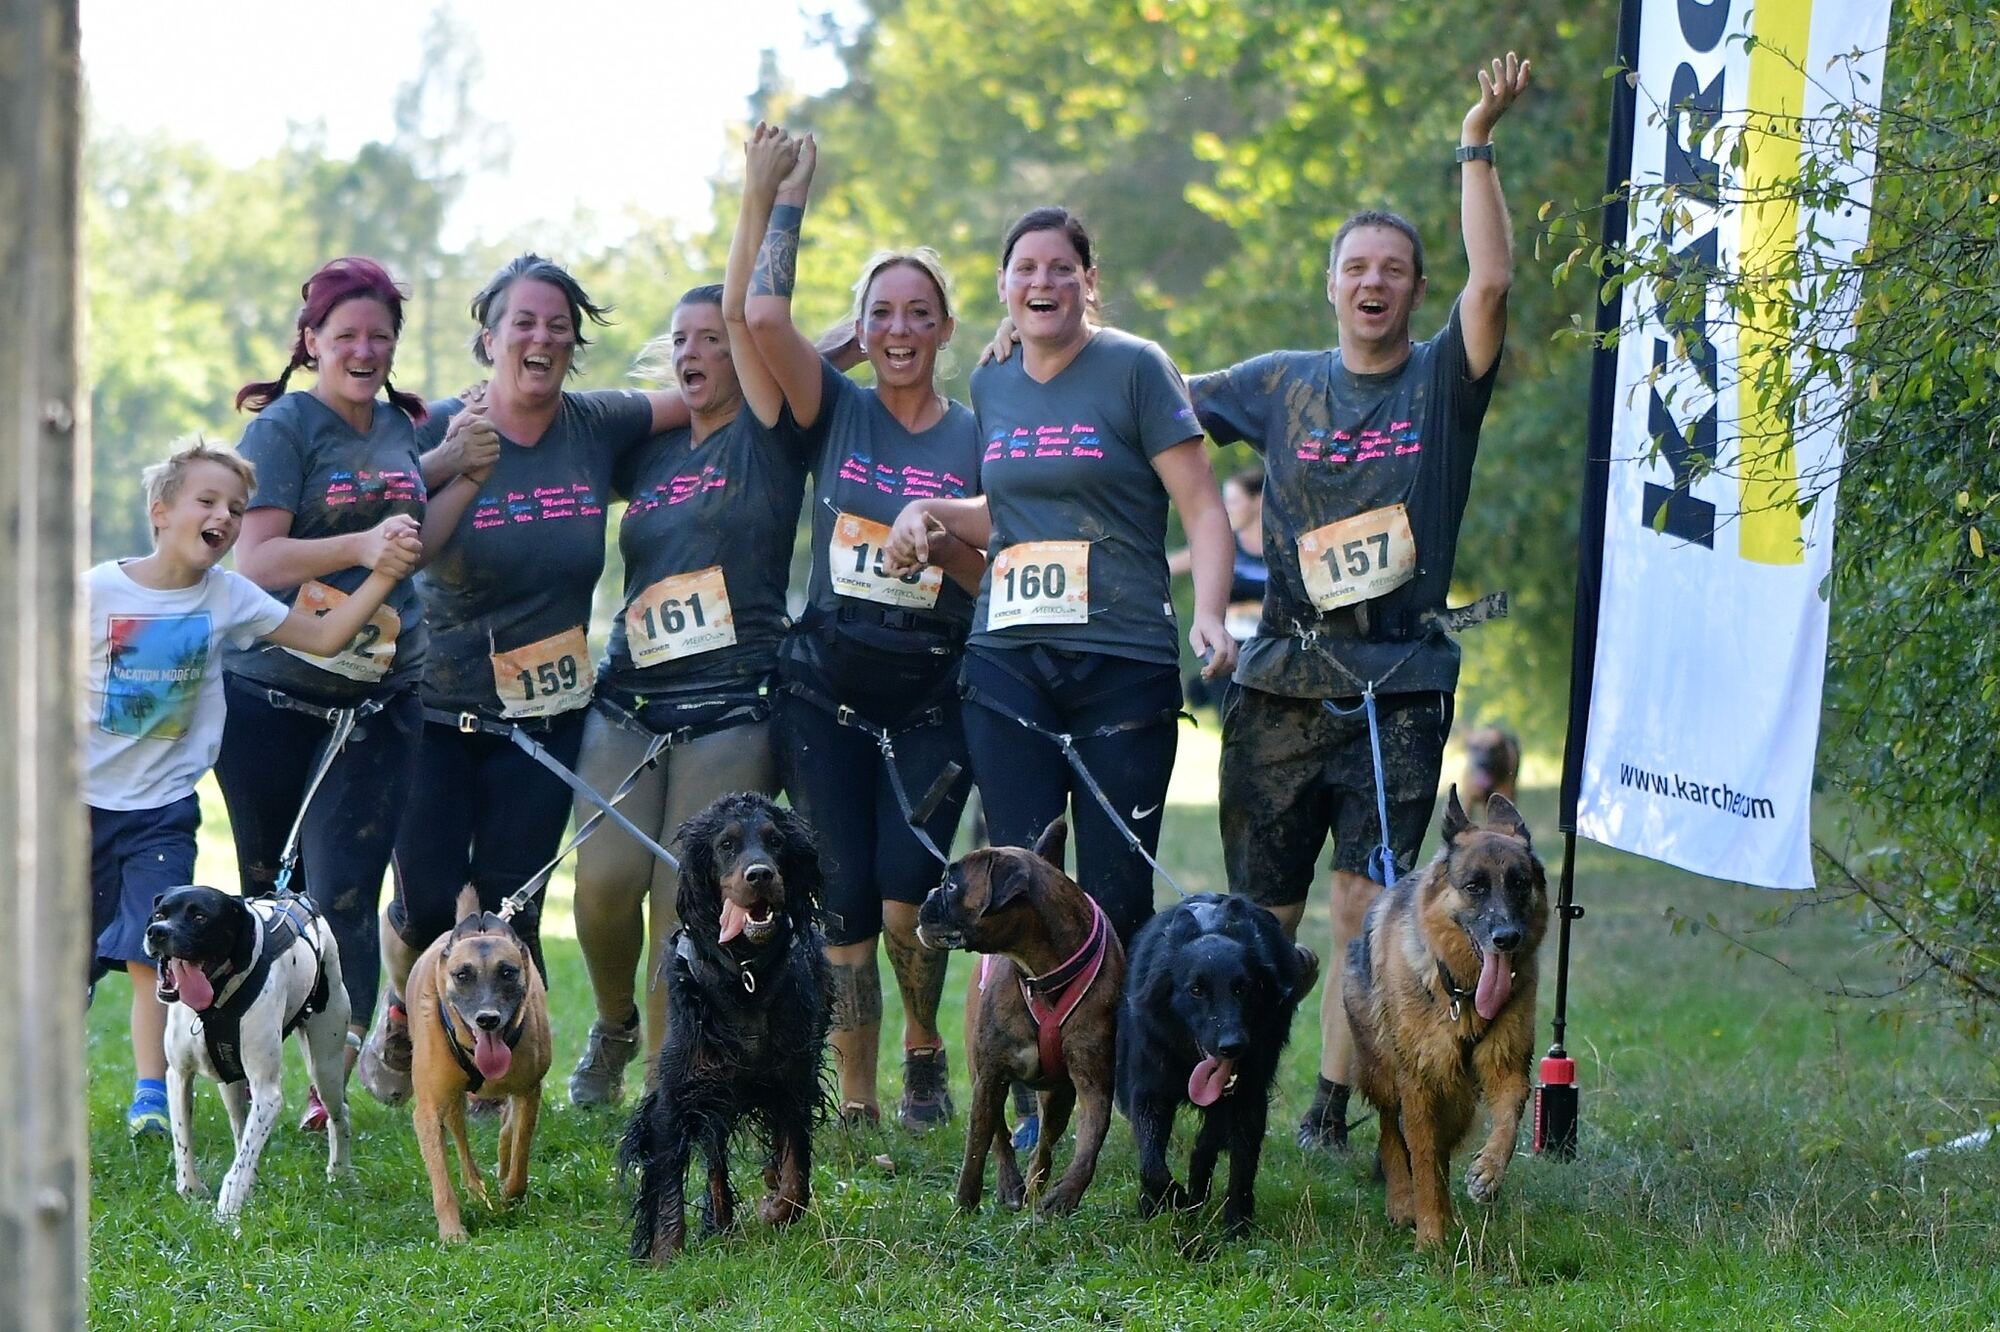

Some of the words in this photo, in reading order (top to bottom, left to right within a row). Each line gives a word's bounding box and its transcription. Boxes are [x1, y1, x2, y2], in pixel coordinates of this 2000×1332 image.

[1320, 532, 1389, 583] 157
[1004, 563, 1066, 602] 160
[641, 592, 706, 641] 161
[113, 666, 160, 681] VACATION
[517, 655, 577, 701] 159
